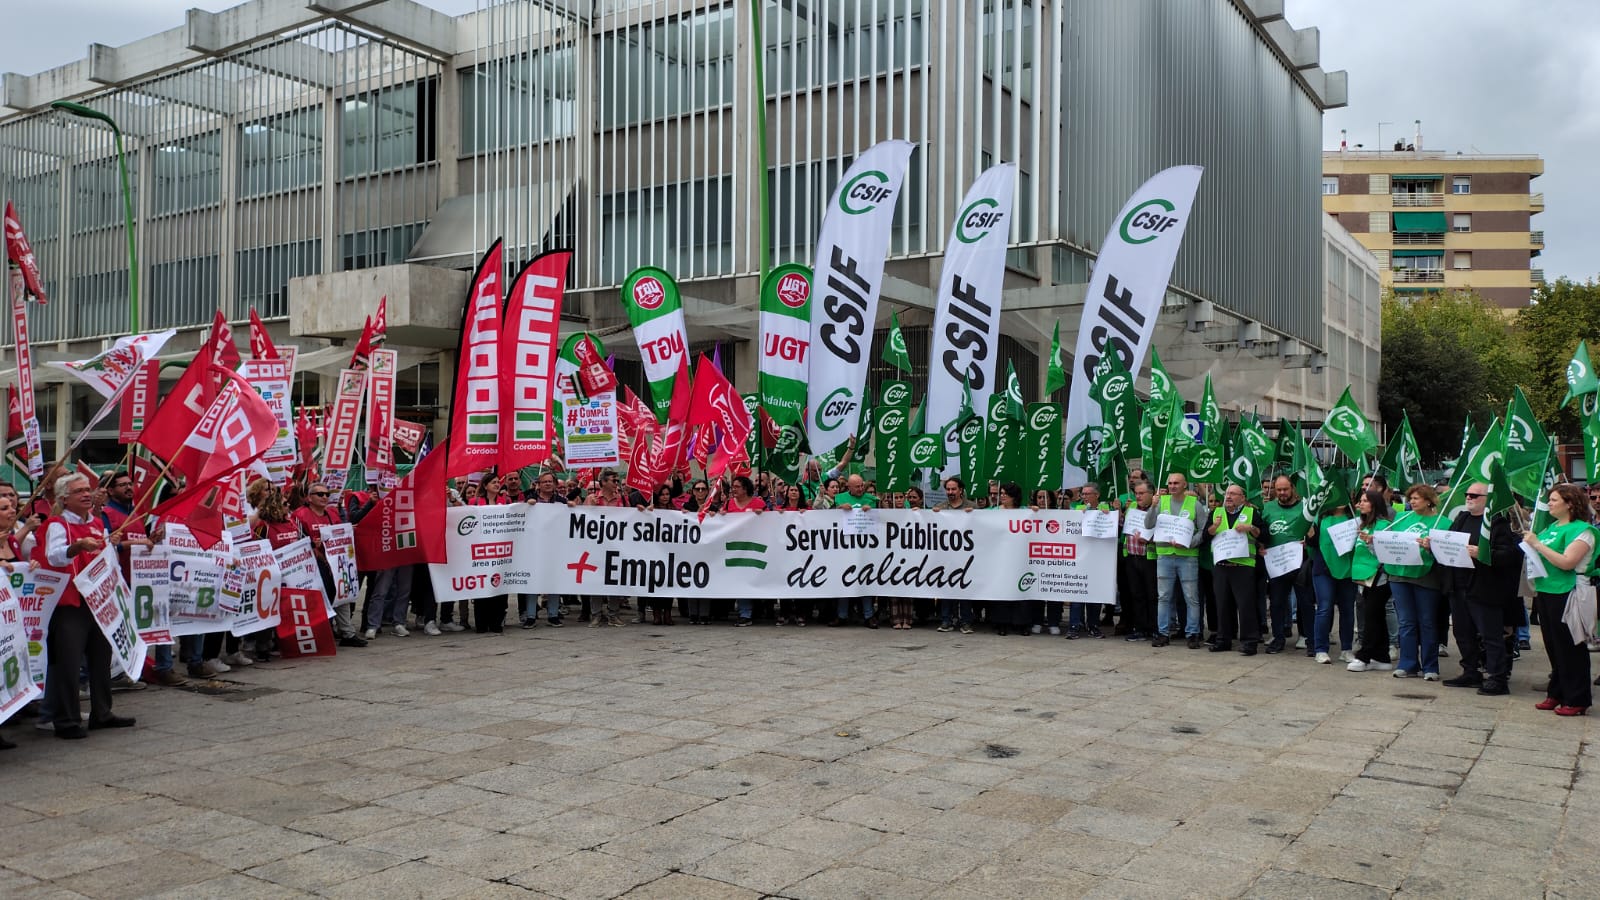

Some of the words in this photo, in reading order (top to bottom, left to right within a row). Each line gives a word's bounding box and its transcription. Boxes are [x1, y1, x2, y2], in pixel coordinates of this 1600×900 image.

[850, 183, 893, 203] CSIF
[964, 212, 1003, 228] CSIF
[1131, 212, 1179, 233] CSIF
[820, 244, 871, 364] CSIF
[941, 273, 992, 390] CSIF
[466, 272, 498, 410] CCOO
[514, 274, 558, 410] CCOO
[765, 333, 809, 363] UGT
[247, 364, 285, 377] COO
[890, 389, 908, 400] CSIF
[1108, 382, 1129, 393] CSIF
[824, 401, 857, 416] CSIF
[884, 416, 904, 426] CSIF
[1036, 413, 1058, 423] CSIF
[331, 402, 354, 465] CCOO
[965, 425, 981, 435] CSIF
[465, 446, 498, 455] Córdoba
[513, 442, 546, 451] Córdoba
[916, 445, 937, 456] CSIF
[993, 425, 1009, 477] CSIF
[887, 436, 898, 489] CSIF
[1037, 432, 1050, 487] CSIF
[969, 444, 979, 496] CSIF
[382, 496, 393, 552] Córdoba
[569, 513, 627, 544] Mejor
[633, 518, 702, 544] salario
[1009, 519, 1043, 533] UGT
[786, 522, 879, 551] Servicios
[886, 522, 975, 551] Públicos
[474, 545, 511, 557] CCOO
[1031, 545, 1074, 556] CCOO
[471, 560, 490, 568] área
[491, 558, 513, 567] pública
[604, 550, 710, 593] Empleo
[787, 554, 828, 589] de
[841, 552, 975, 590] calidad
[1047, 558, 1076, 567] pública
[452, 574, 488, 591] UGT
[503, 571, 531, 579] Servicios
[1040, 580, 1083, 588] Independiente
[256, 569, 280, 620] C2
[289, 594, 317, 654] CCOO
